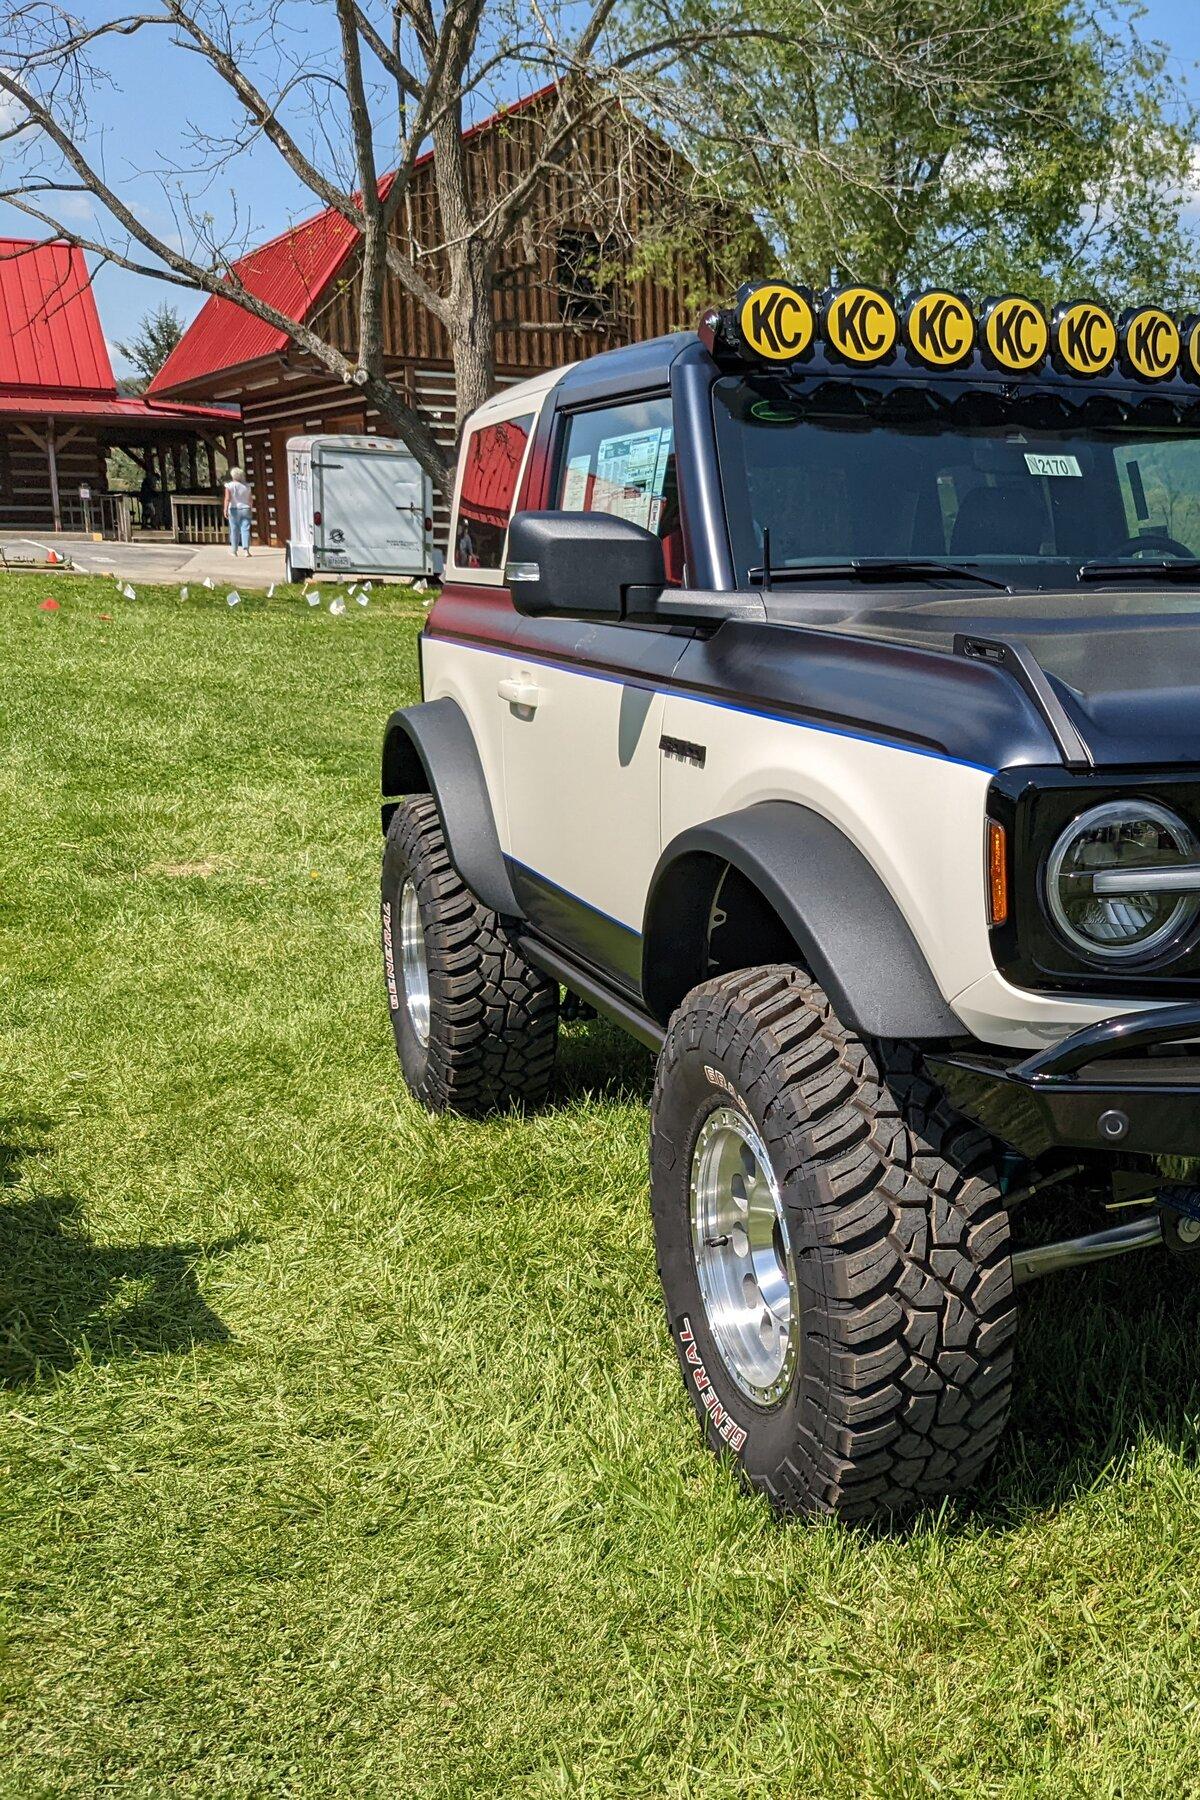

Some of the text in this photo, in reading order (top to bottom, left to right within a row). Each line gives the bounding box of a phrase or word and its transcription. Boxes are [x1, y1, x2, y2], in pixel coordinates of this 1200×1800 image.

[751, 292, 802, 353] KC
[838, 295, 885, 354] KC
[918, 300, 963, 358] KC
[996, 305, 1038, 362] KC
[1067, 310, 1107, 367] KC
[1135, 316, 1172, 371] KC
[680, 1317, 748, 1451] GENERAL
